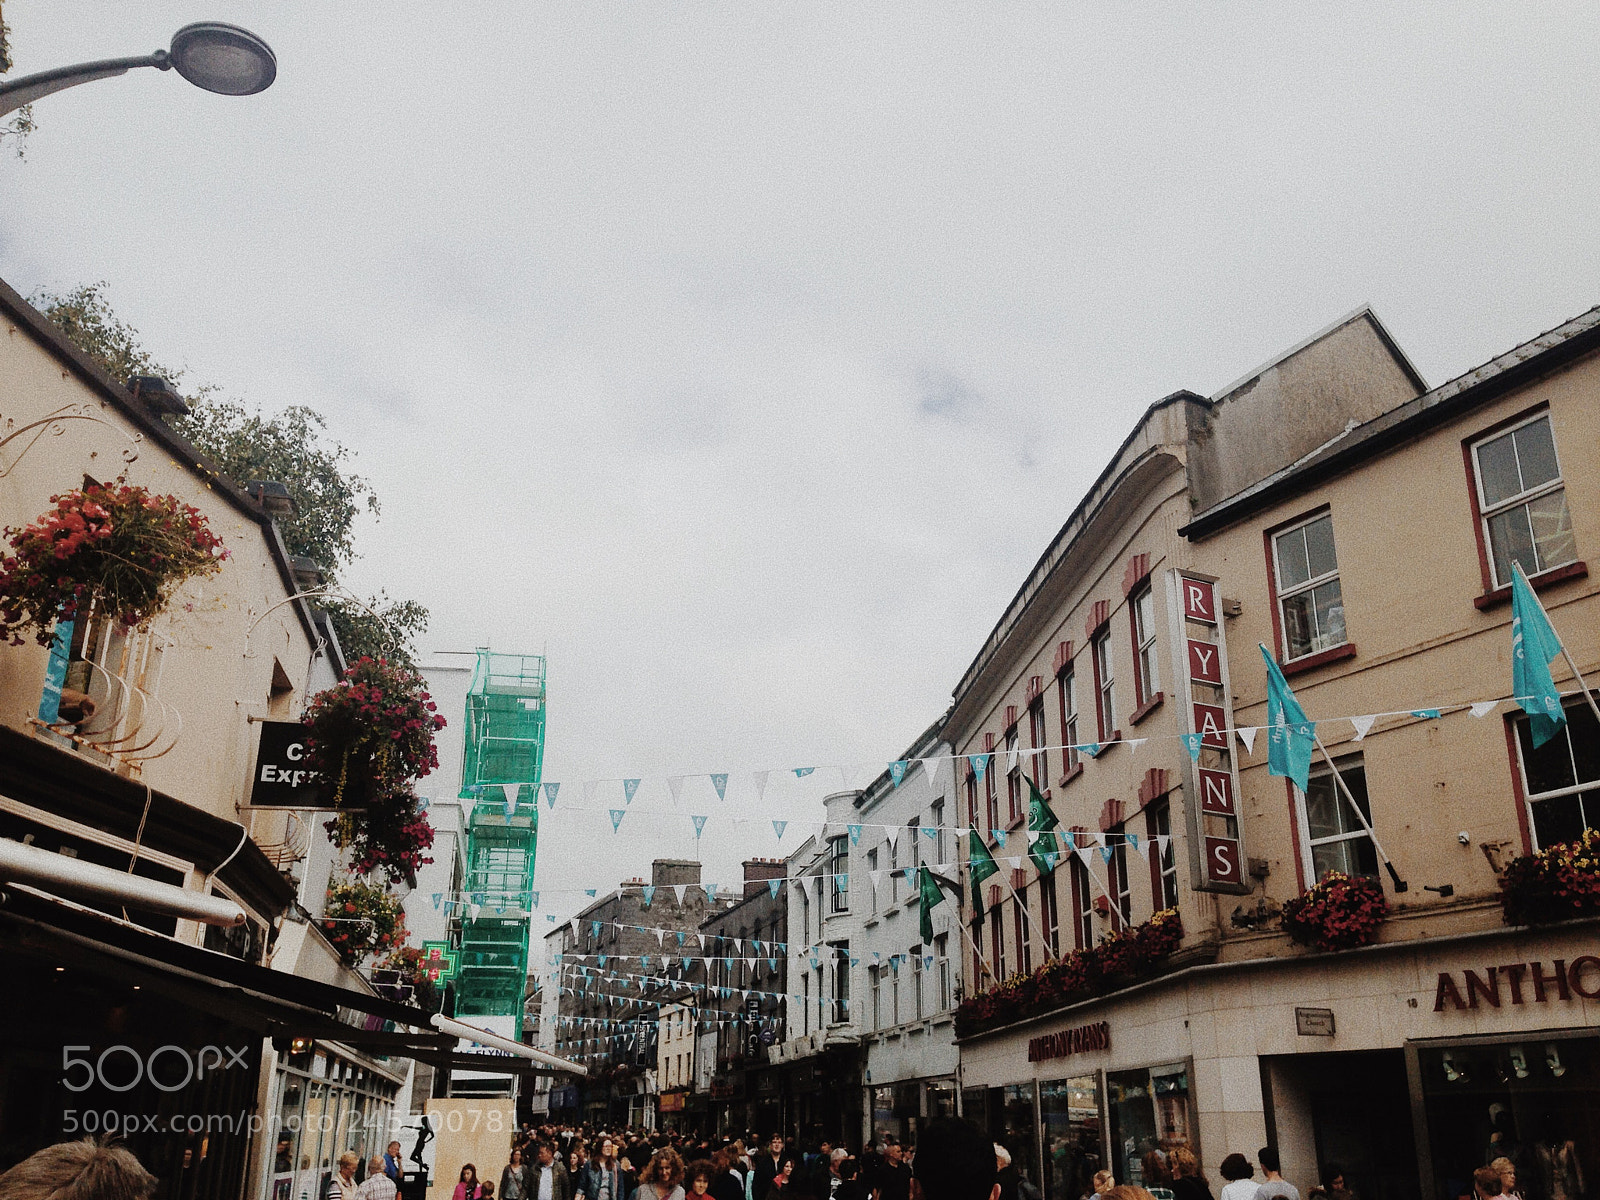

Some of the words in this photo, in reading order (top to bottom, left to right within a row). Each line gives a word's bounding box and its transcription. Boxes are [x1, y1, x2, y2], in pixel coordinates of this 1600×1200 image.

[1187, 584, 1233, 877] RYANS
[1433, 955, 1600, 1012] ANTHO
[1028, 1029, 1073, 1062] ANTHONY
